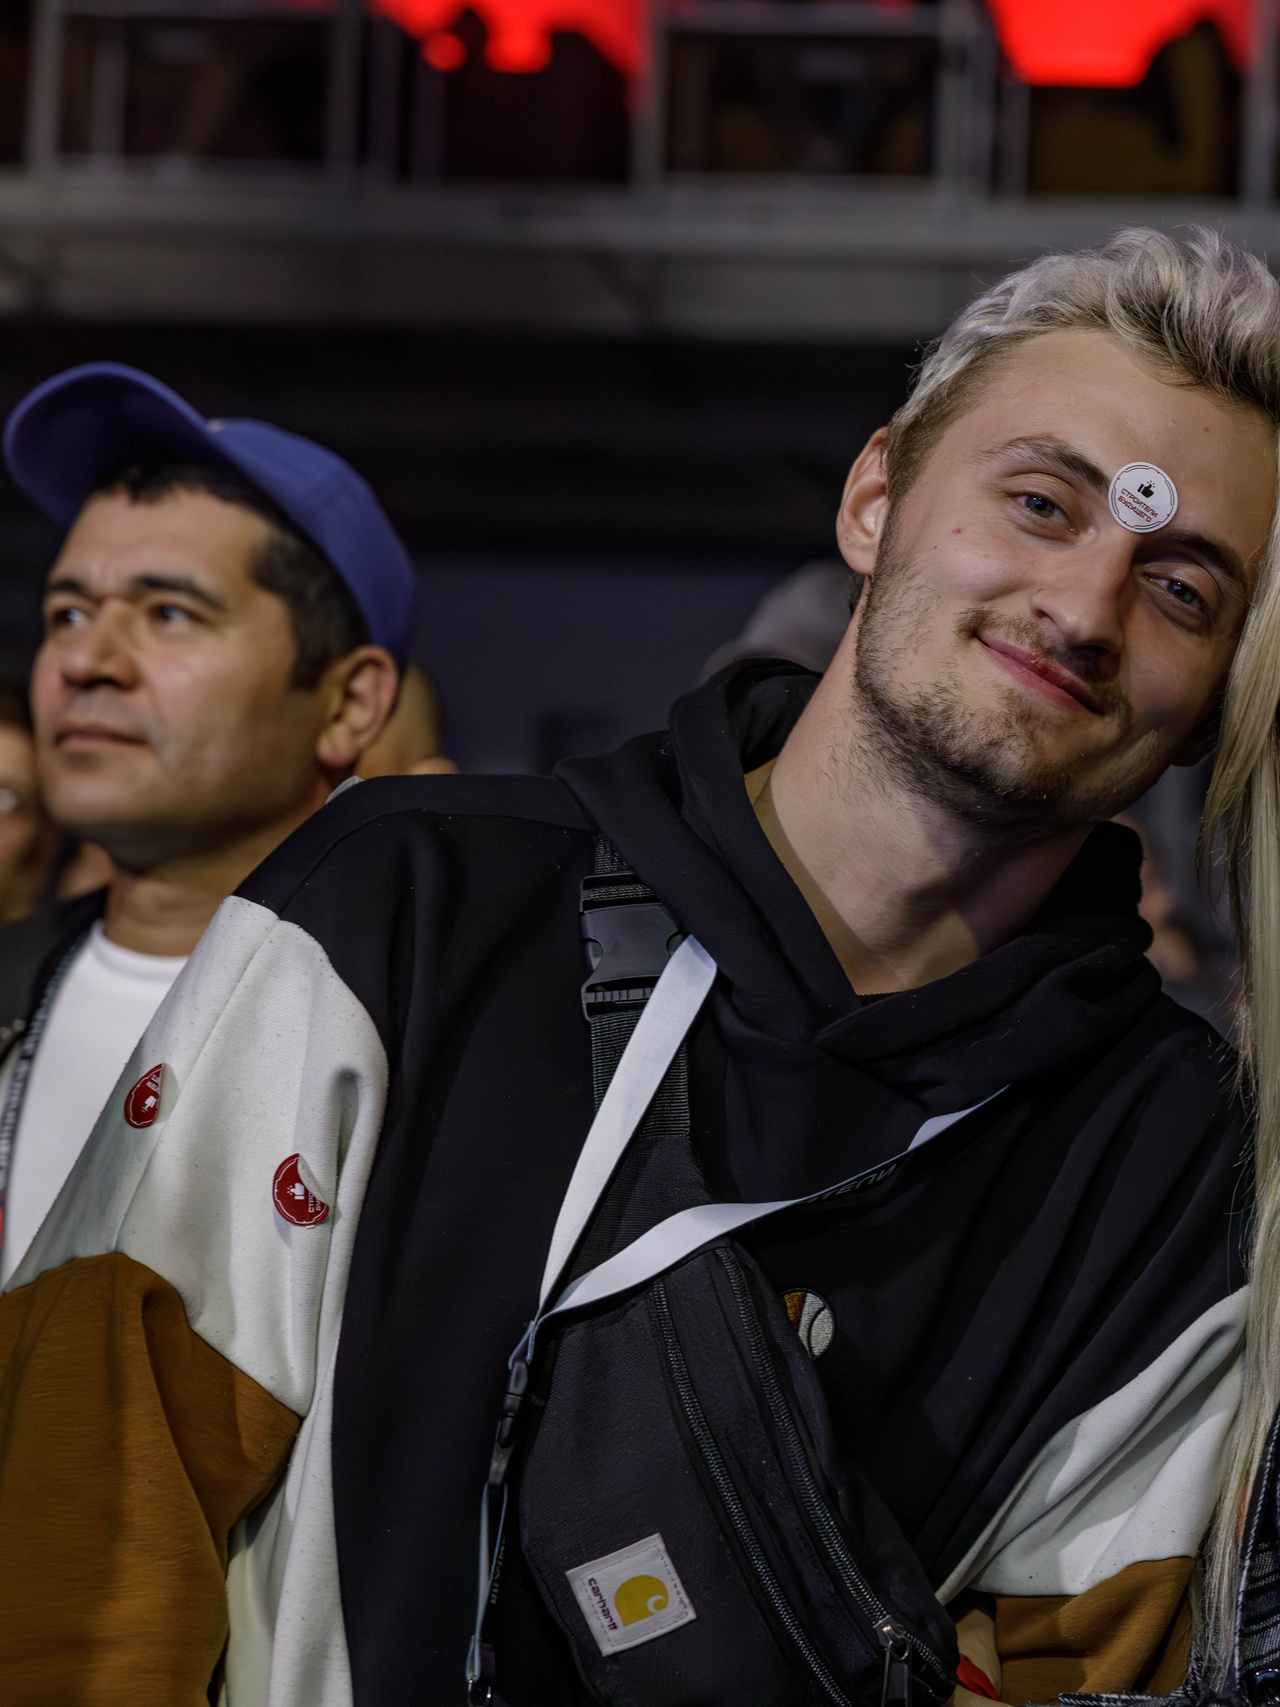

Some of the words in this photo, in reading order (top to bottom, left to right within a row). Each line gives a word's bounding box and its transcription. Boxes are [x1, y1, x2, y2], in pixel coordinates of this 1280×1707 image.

[1117, 495, 1152, 523] БУДУЩЕГО
[1120, 488, 1159, 517] СТРОИТЕЛИ
[587, 1577, 618, 1631] carhartt
